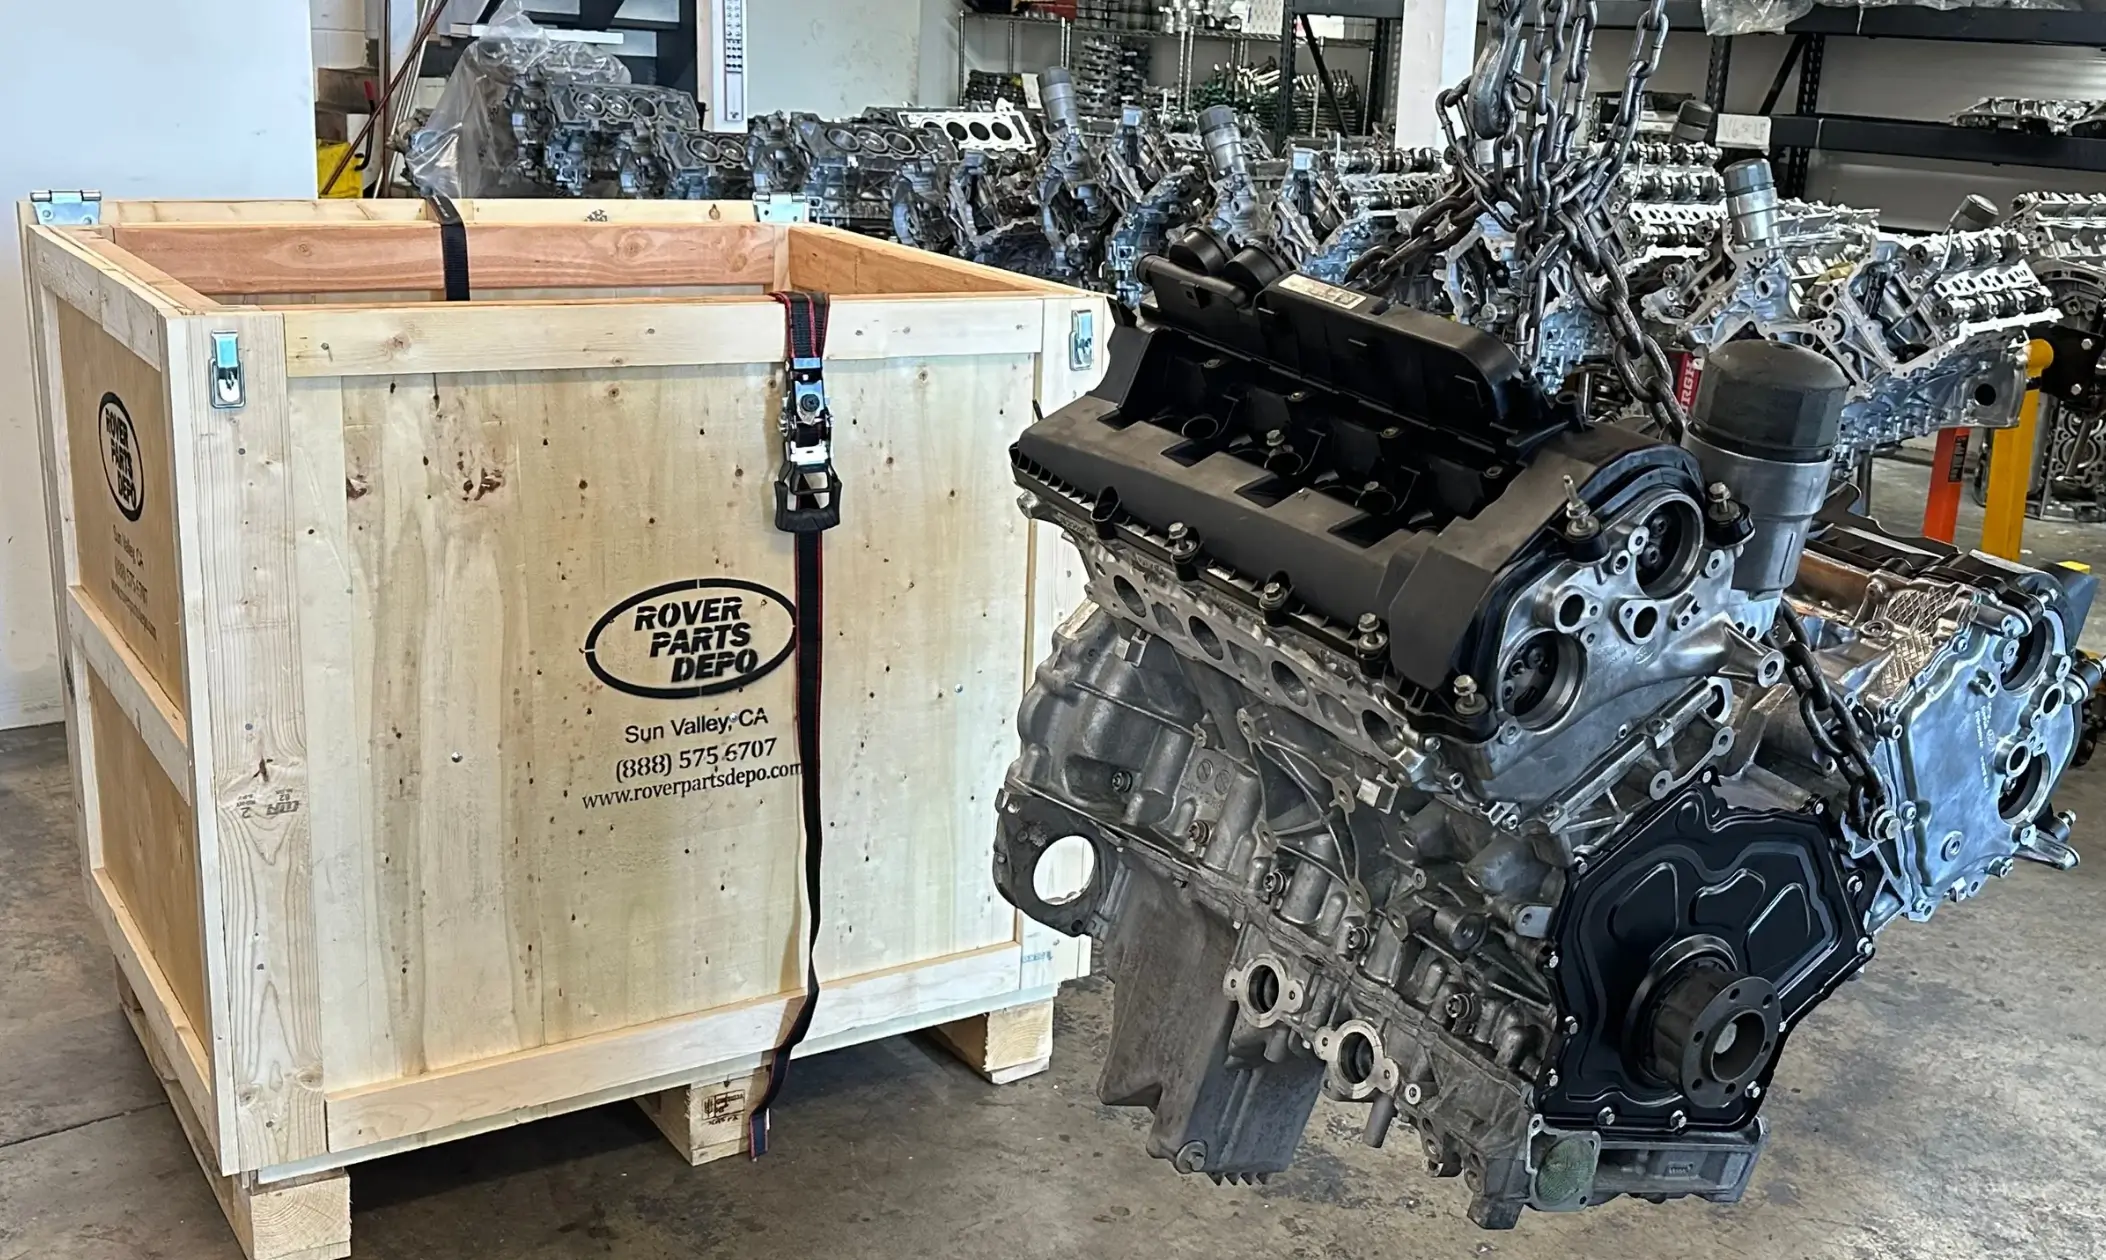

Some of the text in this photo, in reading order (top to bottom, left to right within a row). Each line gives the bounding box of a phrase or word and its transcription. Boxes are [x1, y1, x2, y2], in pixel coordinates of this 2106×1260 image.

[105, 407, 129, 449] ROVER
[110, 438, 133, 478] PARTS
[117, 469, 136, 509] DEPO
[634, 596, 743, 631] ROVER
[649, 622, 752, 658] PARTS
[671, 648, 758, 683] DEPO
[625, 707, 769, 744] Sun Valley, CA
[616, 737, 777, 784] (888) 575 6707
[582, 762, 803, 809] www.roverpartsdepo.com
